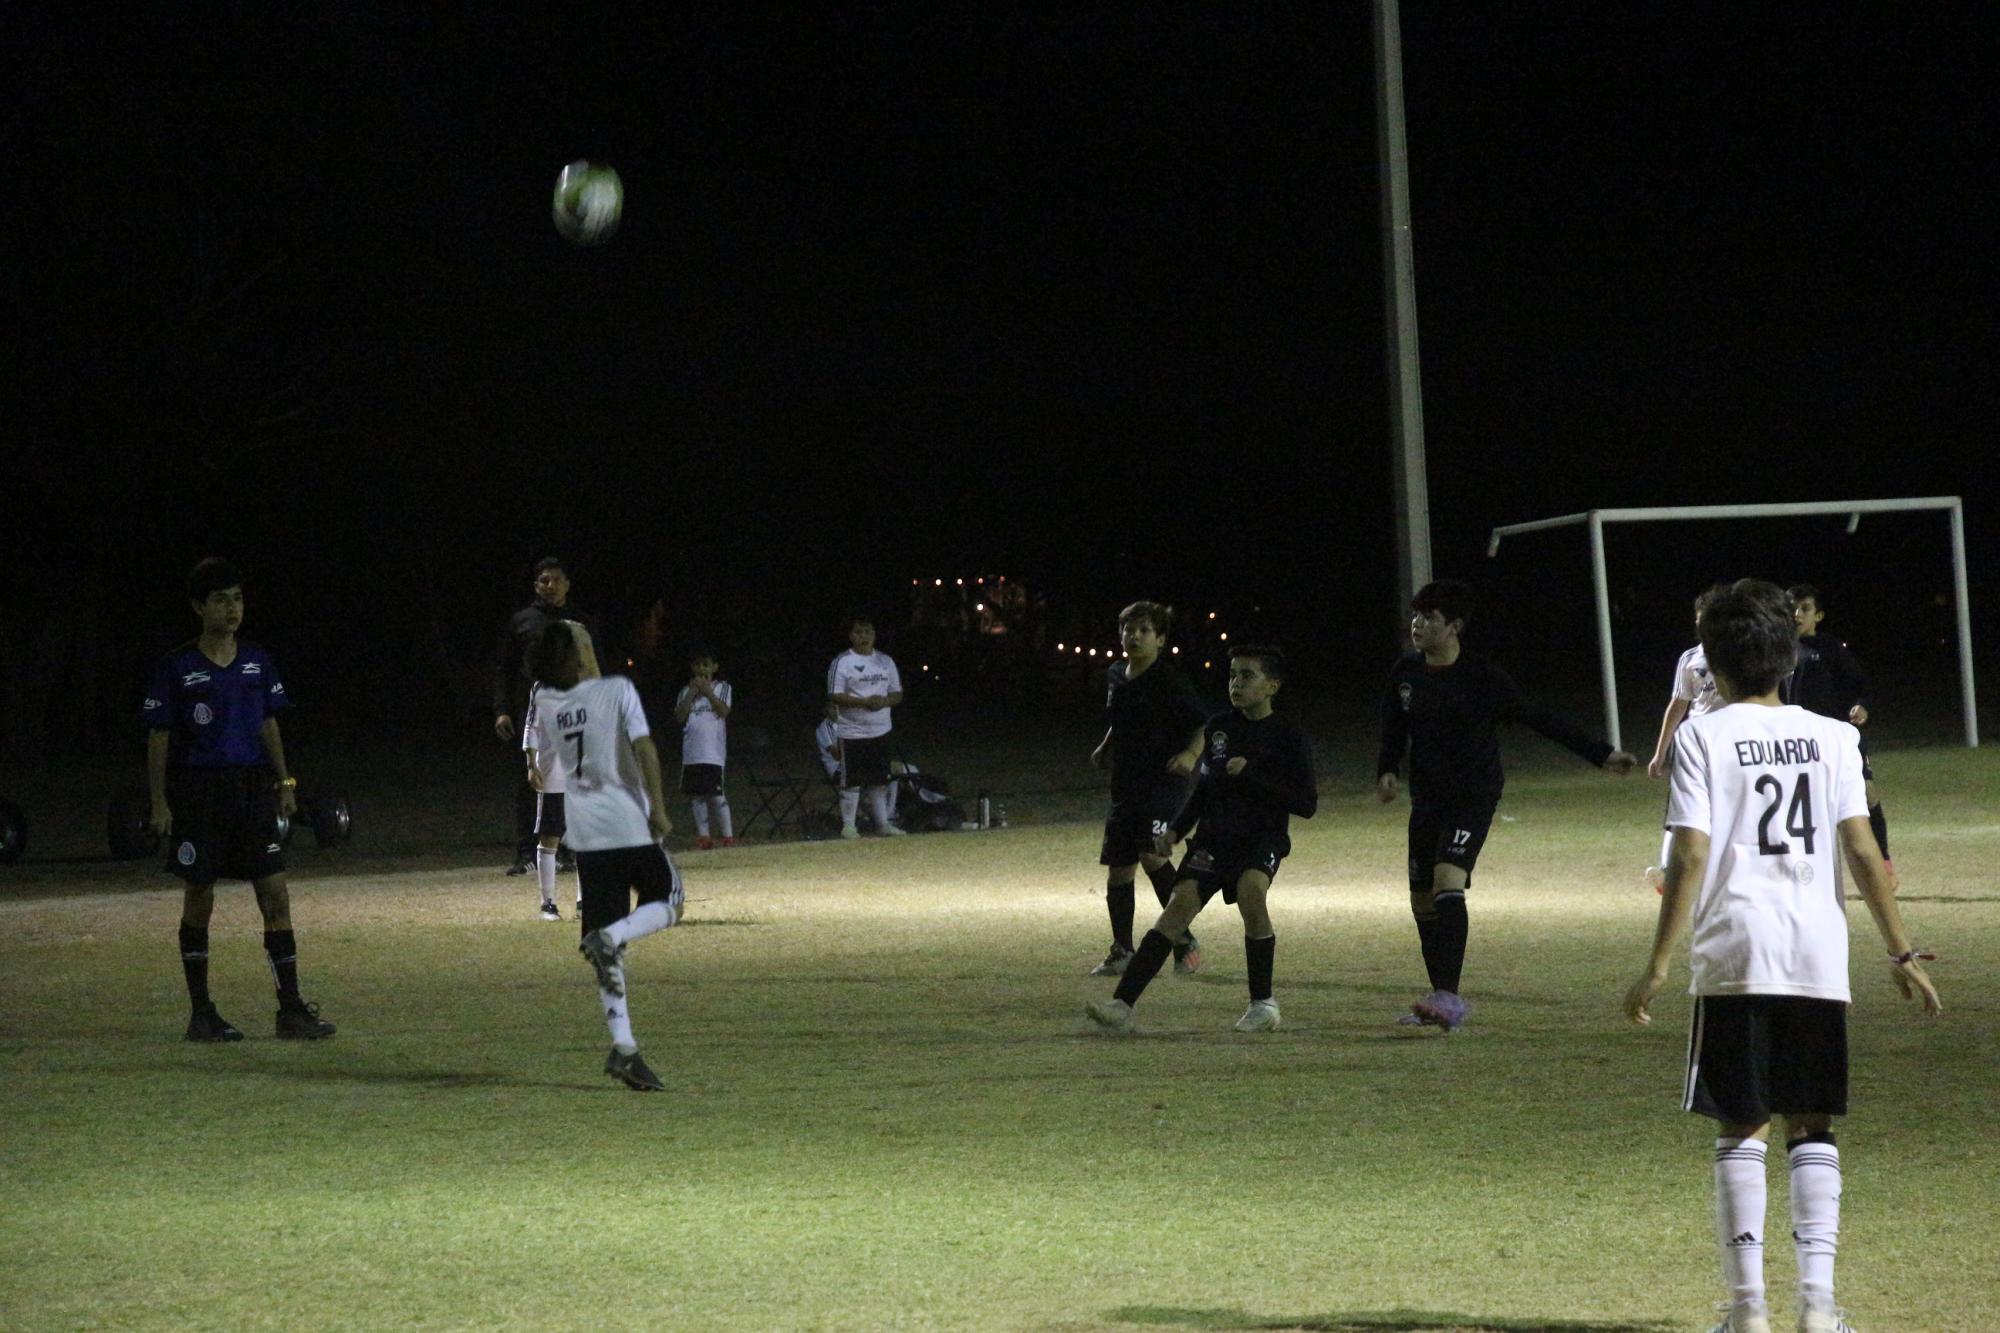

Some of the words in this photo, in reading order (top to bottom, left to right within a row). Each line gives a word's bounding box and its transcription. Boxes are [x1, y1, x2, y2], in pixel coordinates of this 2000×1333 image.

[556, 708, 587, 730] ROJO
[564, 731, 584, 778] 7
[1735, 738, 1820, 766] EDUARDO
[1755, 772, 1816, 855] 24
[1453, 828, 1471, 845] 17
